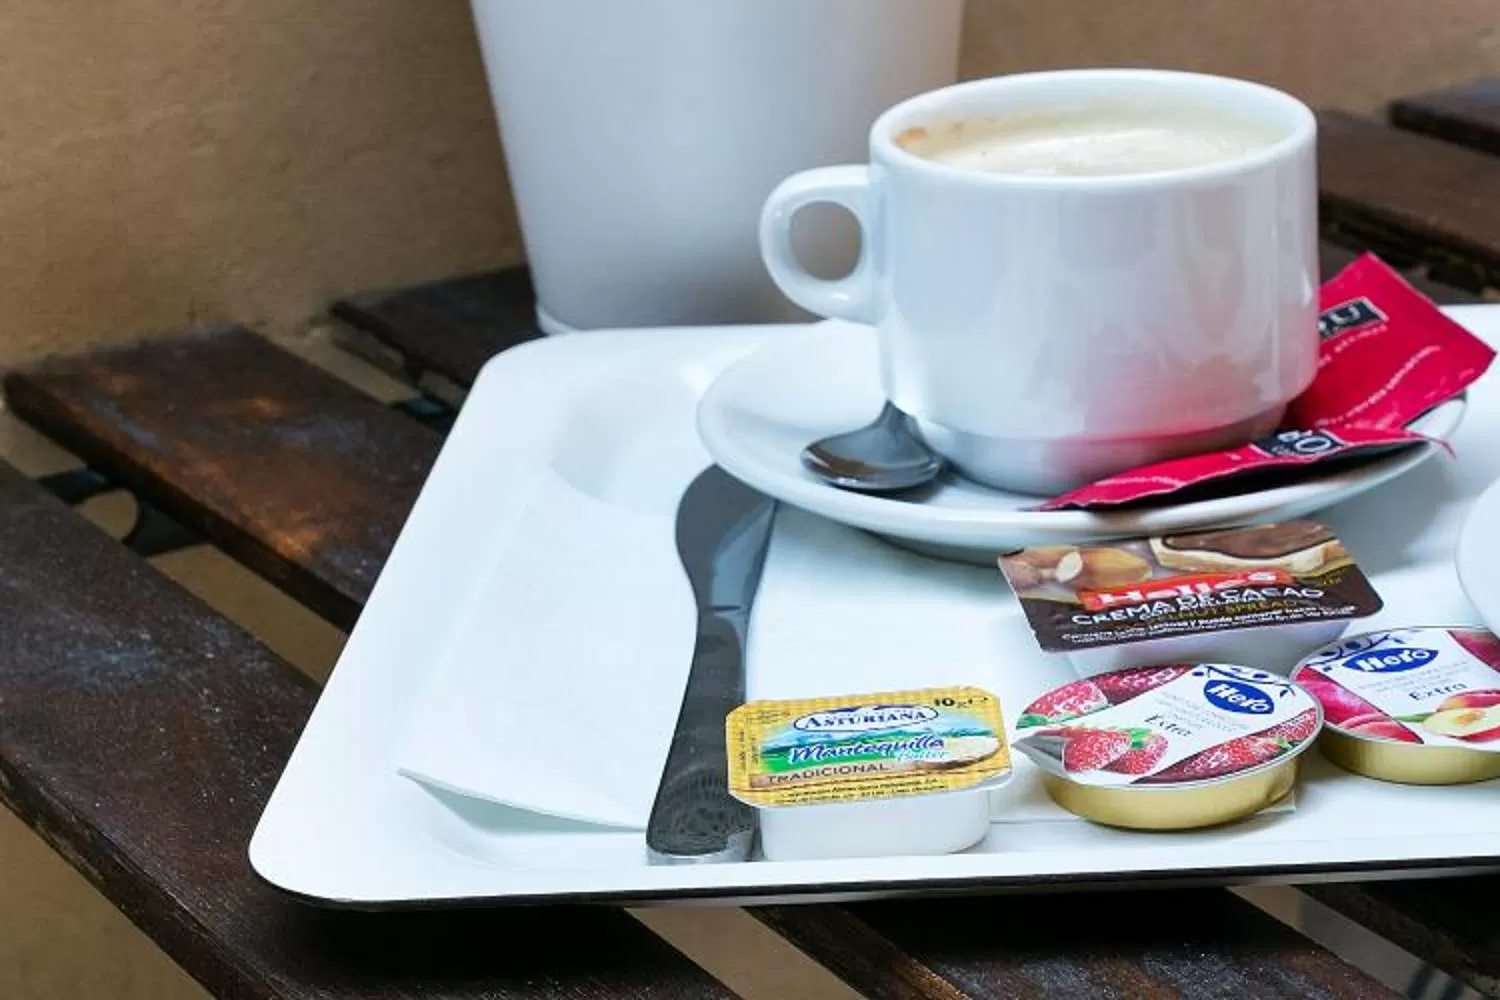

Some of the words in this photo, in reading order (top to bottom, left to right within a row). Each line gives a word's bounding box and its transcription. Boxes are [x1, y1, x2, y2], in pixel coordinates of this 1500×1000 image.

[1071, 601, 1176, 625] CREMA
[1220, 586, 1325, 601] CACAO
[1356, 649, 1430, 671] Hero
[1206, 683, 1271, 712] Hero
[789, 735, 945, 766] Mantequilla
[767, 763, 889, 784] TRADICIONAL
